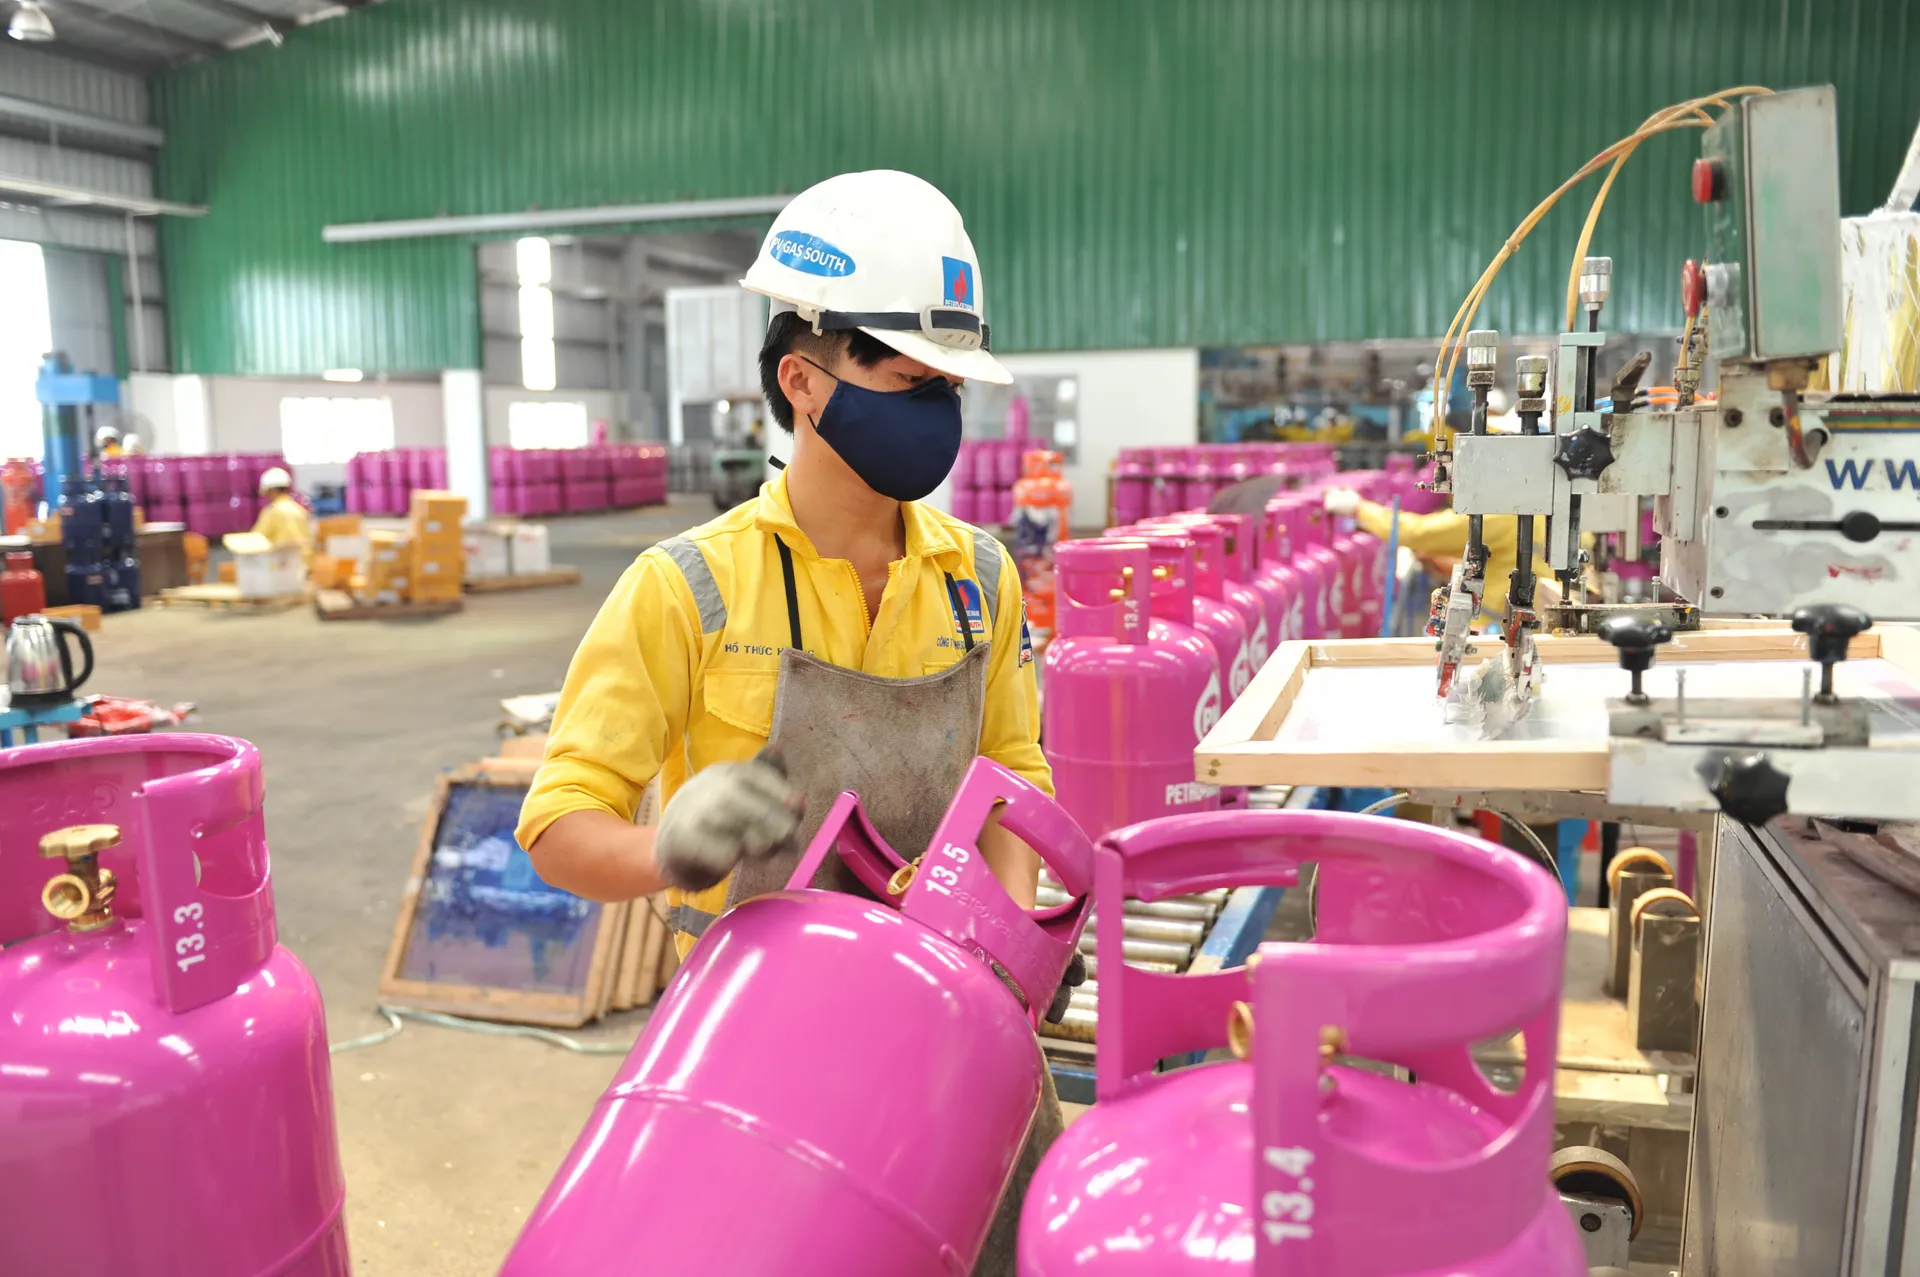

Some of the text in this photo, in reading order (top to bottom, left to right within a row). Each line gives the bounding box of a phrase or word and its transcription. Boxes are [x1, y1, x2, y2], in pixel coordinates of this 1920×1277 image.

[783, 240, 804, 257] GAS
[803, 247, 847, 273] SOUTH
[925, 842, 970, 896] 13.5
[174, 902, 206, 973] 13.3
[1261, 1145, 1316, 1246] 13.4
